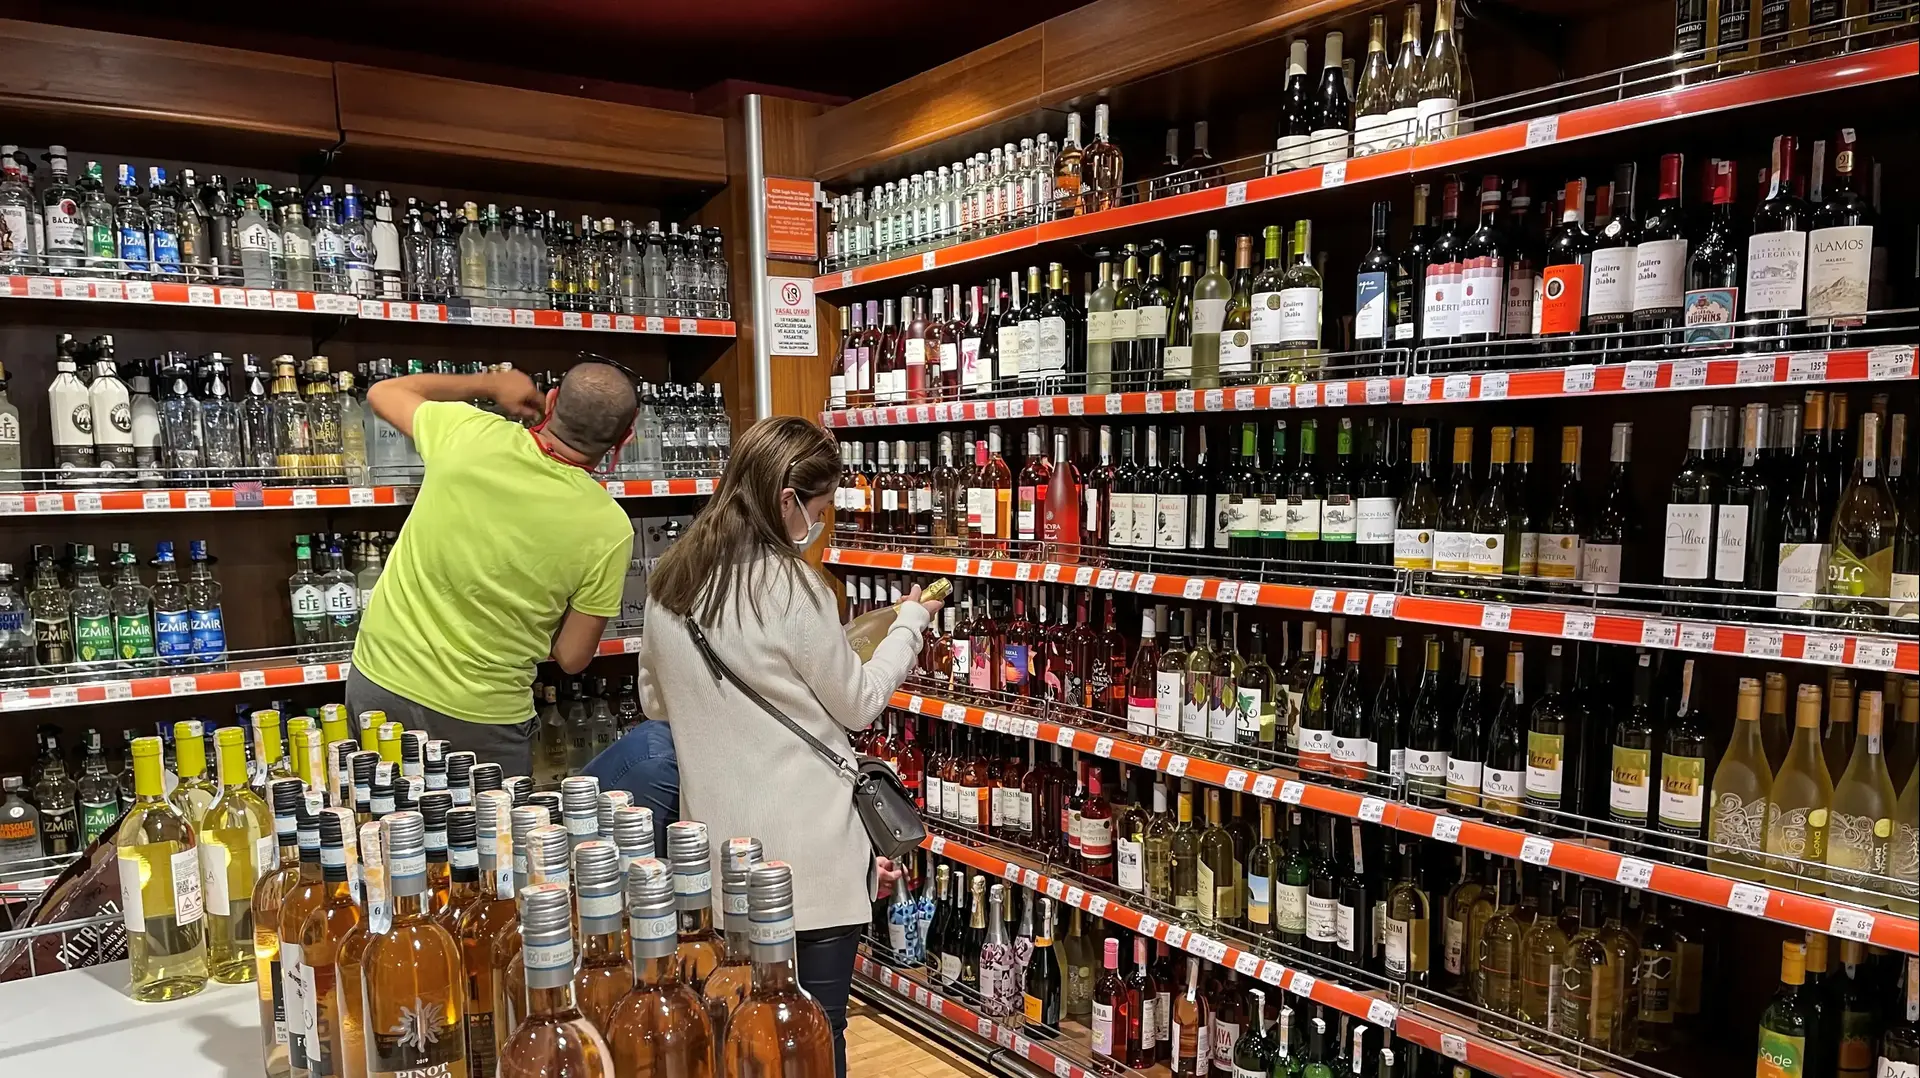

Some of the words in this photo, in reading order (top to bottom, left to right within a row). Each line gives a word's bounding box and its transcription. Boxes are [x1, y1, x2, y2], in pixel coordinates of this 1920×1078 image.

[1839, 153, 1850, 164] 91
[52, 216, 82, 225] BACAR
[98, 233, 114, 242] İZM
[124, 236, 146, 246] İZM
[157, 237, 178, 248] İZM
[249, 232, 266, 246] EFE
[1813, 239, 1864, 253] ALAMOS
[1894, 354, 1904, 364] 59
[1757, 364, 1768, 373] 209
[1810, 362, 1821, 370] 135
[1692, 368, 1702, 376] 139
[379, 429, 402, 440] İZM
[1438, 551, 1470, 559] FRONTE
[1828, 565, 1863, 582] DLC
[299, 595, 319, 611] EFE
[332, 592, 352, 608] EFE
[0, 613, 24, 622] SOLUT
[157, 620, 188, 633] İZMİR
[190, 616, 221, 632] İZMİR
[37, 629, 69, 641] İZMİR
[79, 625, 110, 638] İZMİR
[119, 625, 150, 636] İZMİR
[1409, 763, 1441, 772] ANCYRA
[1448, 772, 1464, 781] CYRA
[84, 812, 115, 825] İZMİR
[44, 820, 74, 832] İZMİR
[1388, 922, 1403, 933] LSIM
[1857, 920, 1866, 929] 65
[1760, 1047, 1792, 1068] Sade
[395, 1062, 448, 1078] PINOT
